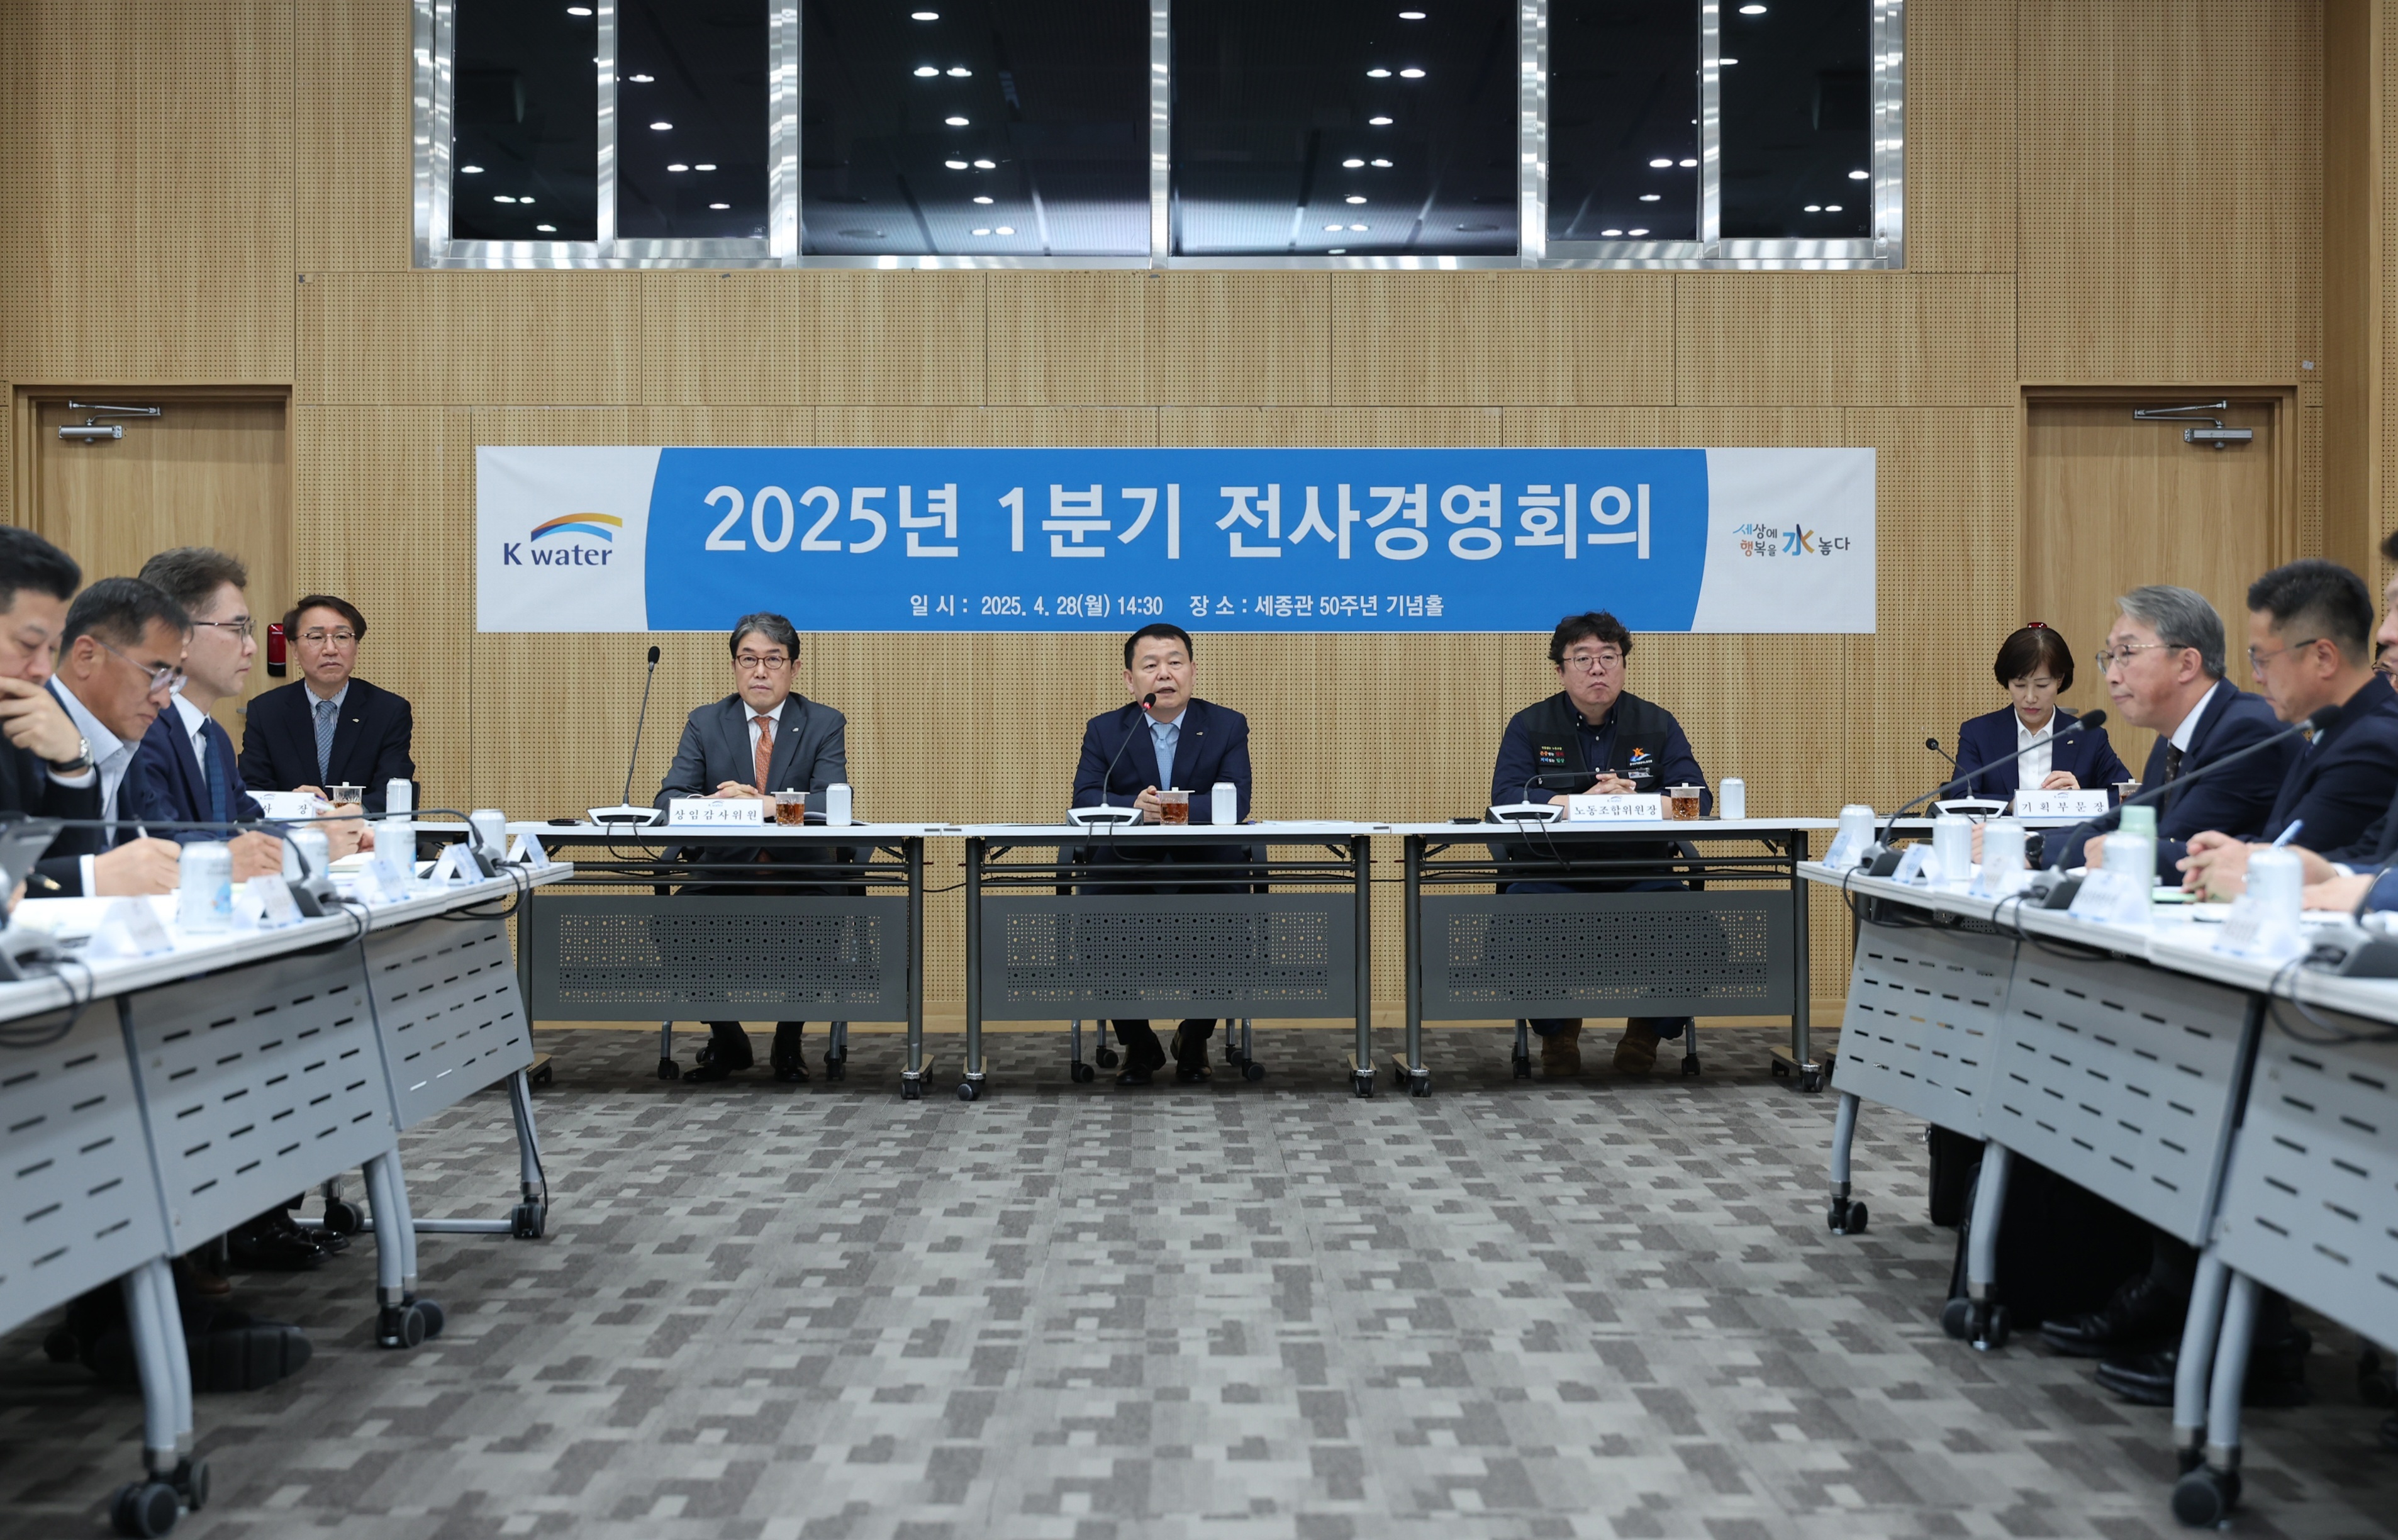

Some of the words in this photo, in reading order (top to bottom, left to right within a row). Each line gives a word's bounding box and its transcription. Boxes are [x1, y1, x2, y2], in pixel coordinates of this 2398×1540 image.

[704, 483, 959, 557] 2025년
[998, 483, 1179, 559] 1분기
[1215, 483, 1650, 561] 전사경영회의
[1732, 523, 1778, 539] 세상에
[531, 544, 613, 566] water
[1740, 539, 1777, 557] 행복을
[1818, 537, 1851, 556] 놓다
[981, 596, 1027, 616] 2025.
[1034, 596, 1049, 616] 4.
[1057, 594, 1110, 618] 28(월)
[1117, 596, 1163, 615] 14:30
[1254, 595, 1313, 617] 세종관
[1320, 595, 1378, 617] 50주년
[1386, 594, 1444, 617] 기념홀
[675, 809, 757, 820] 상임감사위원
[1575, 805, 1657, 816] 노동조합위원장
[2022, 801, 2104, 813] 기획부문장
